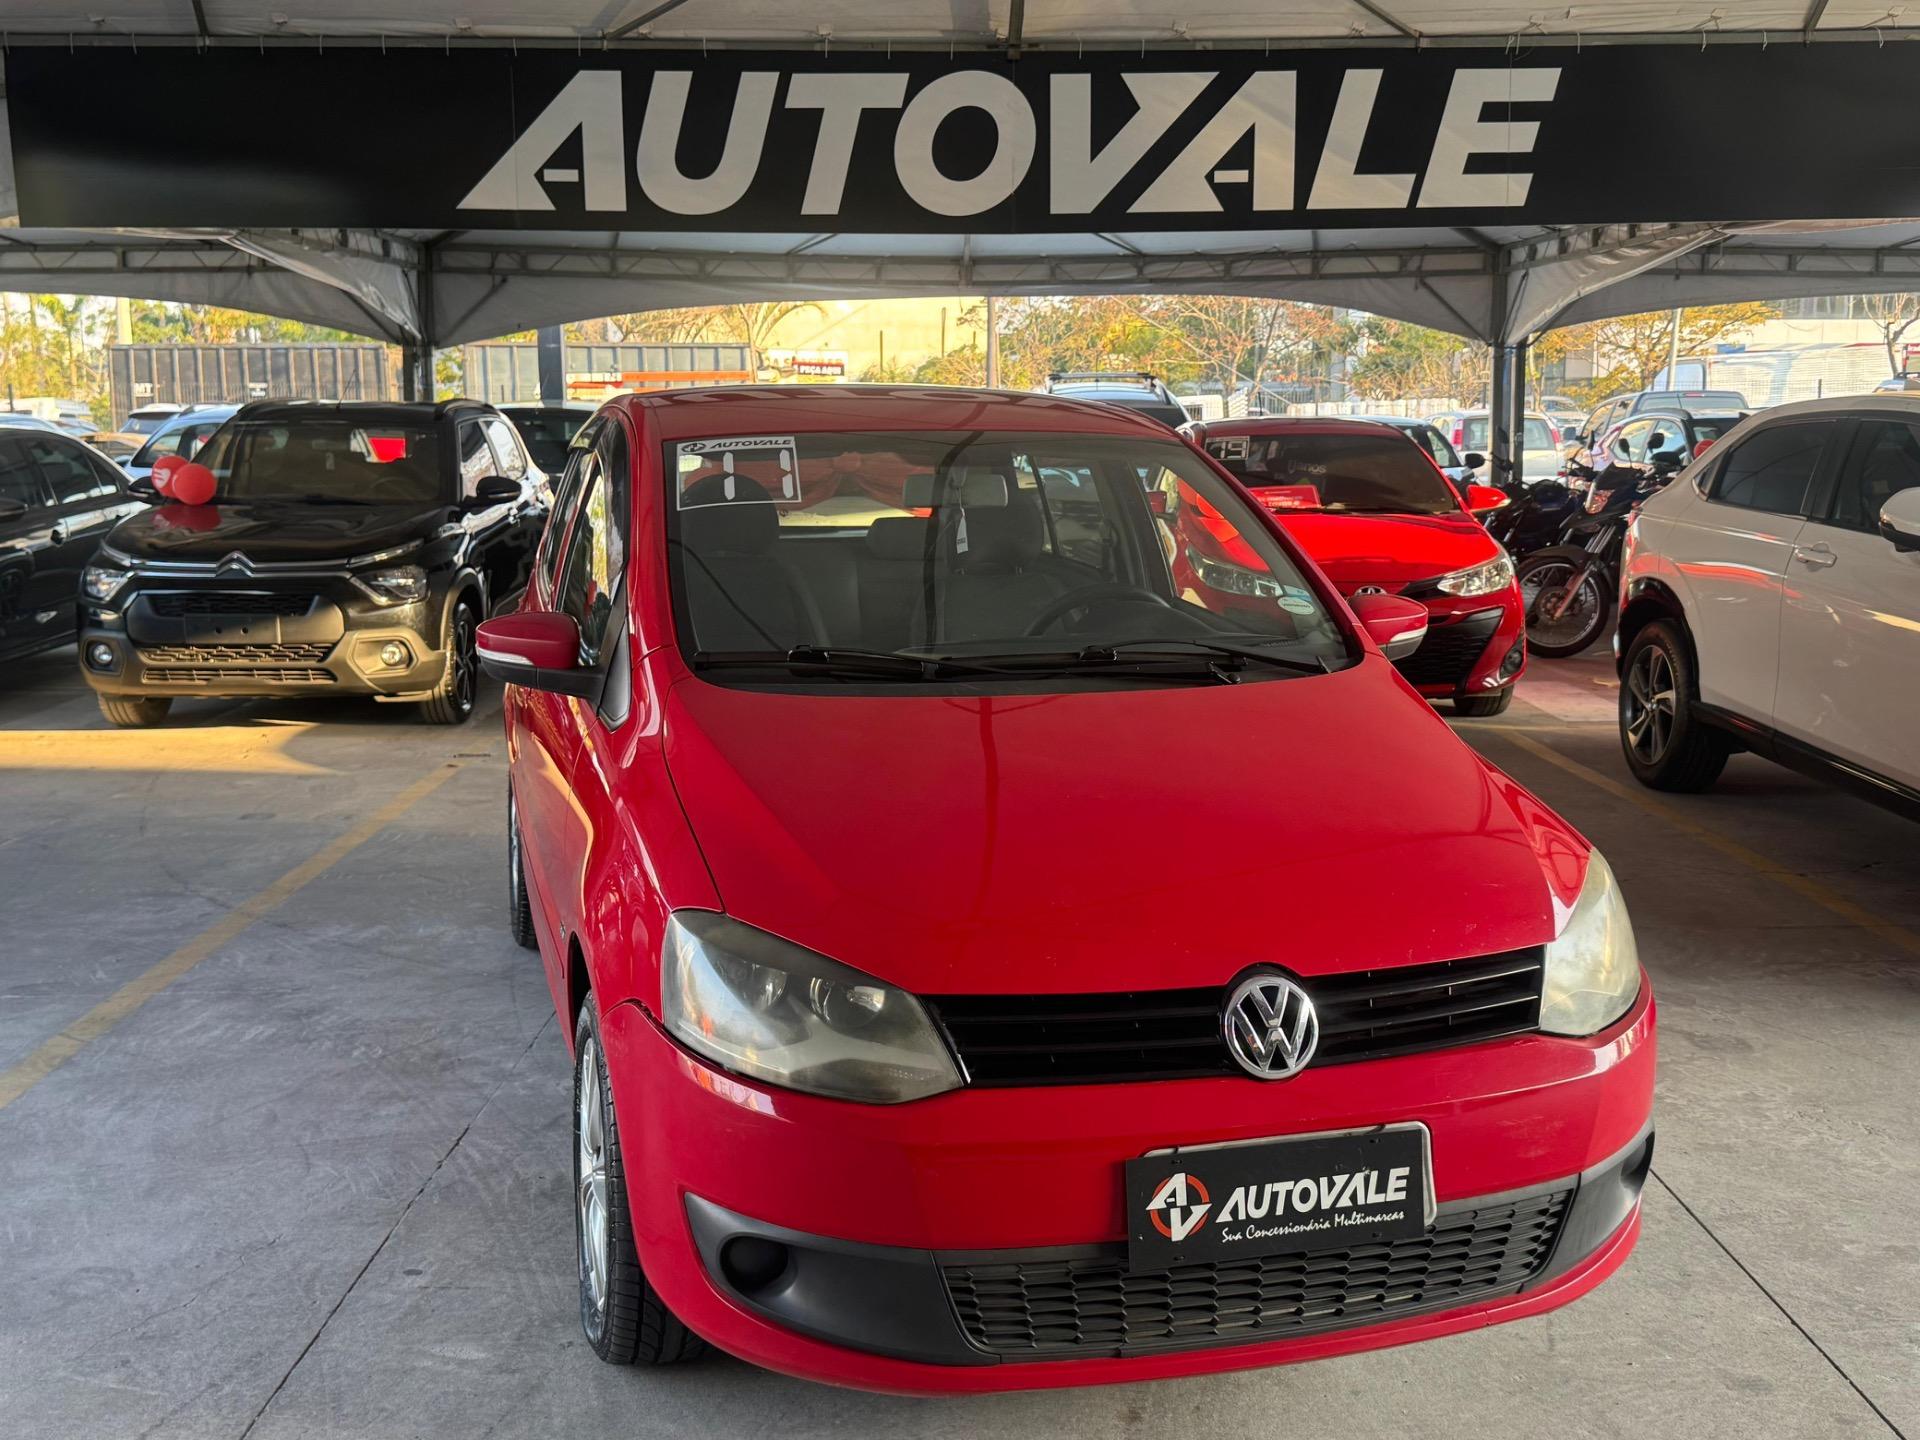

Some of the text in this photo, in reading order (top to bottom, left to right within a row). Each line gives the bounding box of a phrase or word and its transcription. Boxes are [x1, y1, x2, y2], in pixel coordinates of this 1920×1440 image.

[457, 67, 1562, 216] AUTOVALE
[710, 440, 791, 450] AUTOVALE
[1215, 1166, 1410, 1224] AUTOVALE
[1222, 1210, 1404, 1243] Sua Concessionária Multimarcas
